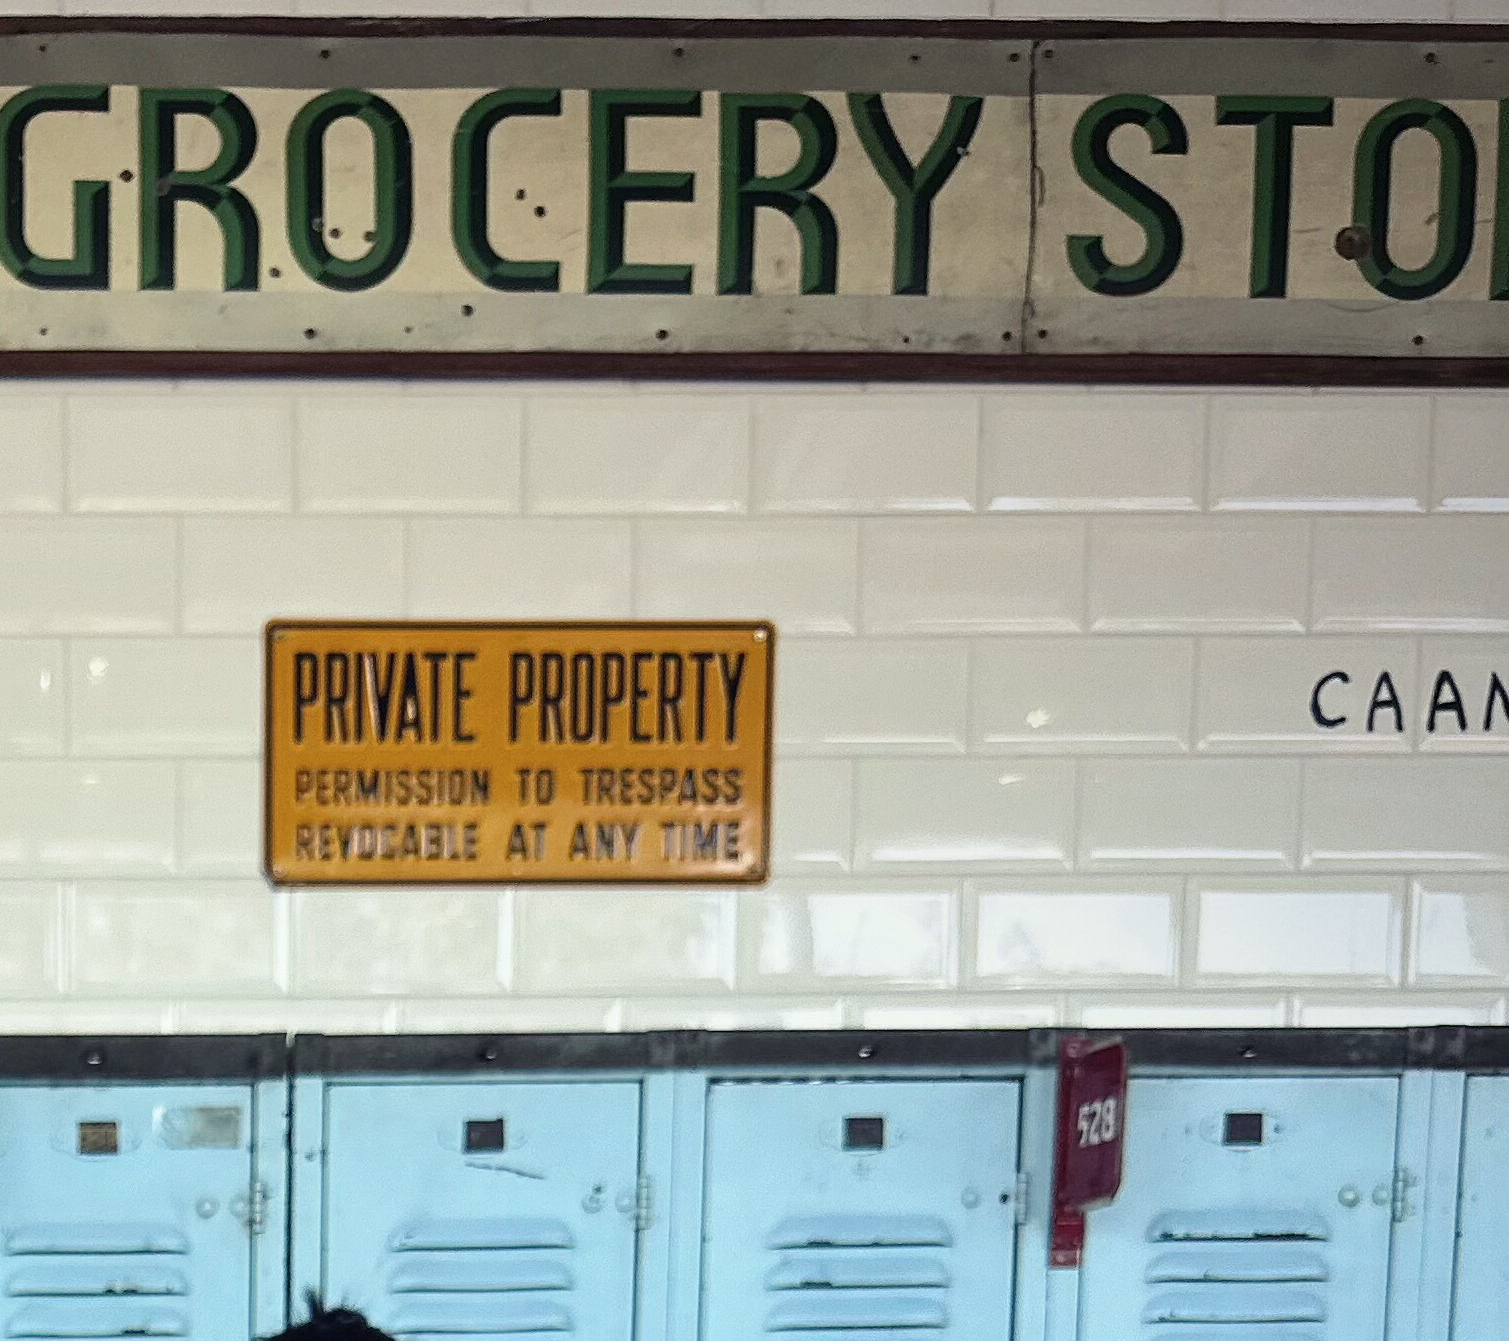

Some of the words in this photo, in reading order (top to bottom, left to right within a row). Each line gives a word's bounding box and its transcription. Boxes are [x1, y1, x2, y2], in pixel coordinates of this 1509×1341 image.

[1066, 94, 1509, 302] STO
[294, 652, 478, 744] PRIVATE
[507, 651, 746, 744] PROPERTY
[1309, 669, 1509, 733] CAAN
[294, 768, 490, 807] PERMISSION
[517, 767, 556, 807] TO
[580, 767, 744, 807] TRESPASS
[295, 822, 481, 863] REVOCABLE
[505, 822, 546, 862] AT
[568, 822, 639, 862] ANY
[658, 822, 743, 862] TIME
[1076, 1096, 1118, 1148] 528
